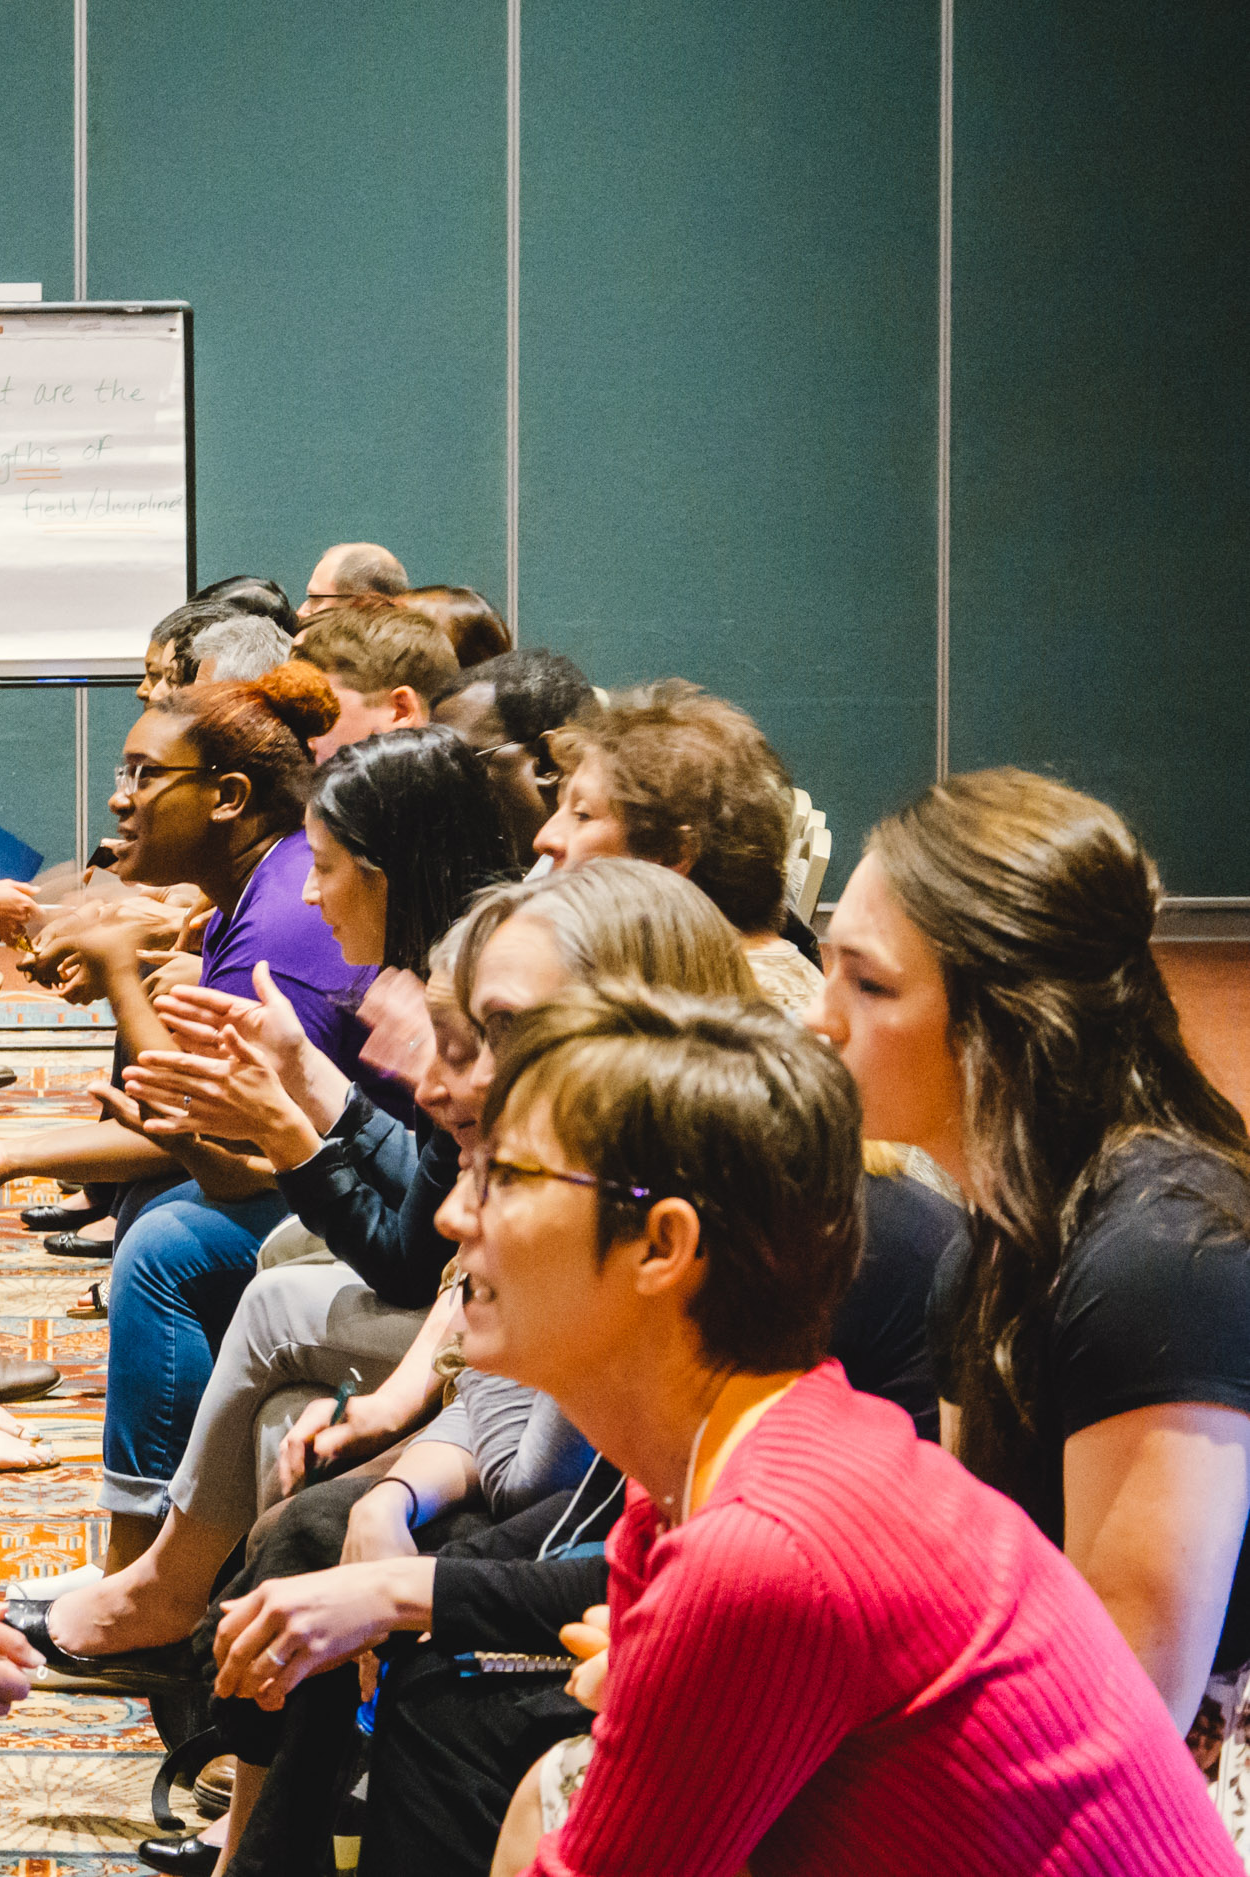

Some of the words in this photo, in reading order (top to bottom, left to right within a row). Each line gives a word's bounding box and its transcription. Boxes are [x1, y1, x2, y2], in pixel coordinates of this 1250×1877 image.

[33, 382, 76, 406] are
[93, 376, 146, 404] the
[81, 434, 114, 462] of
